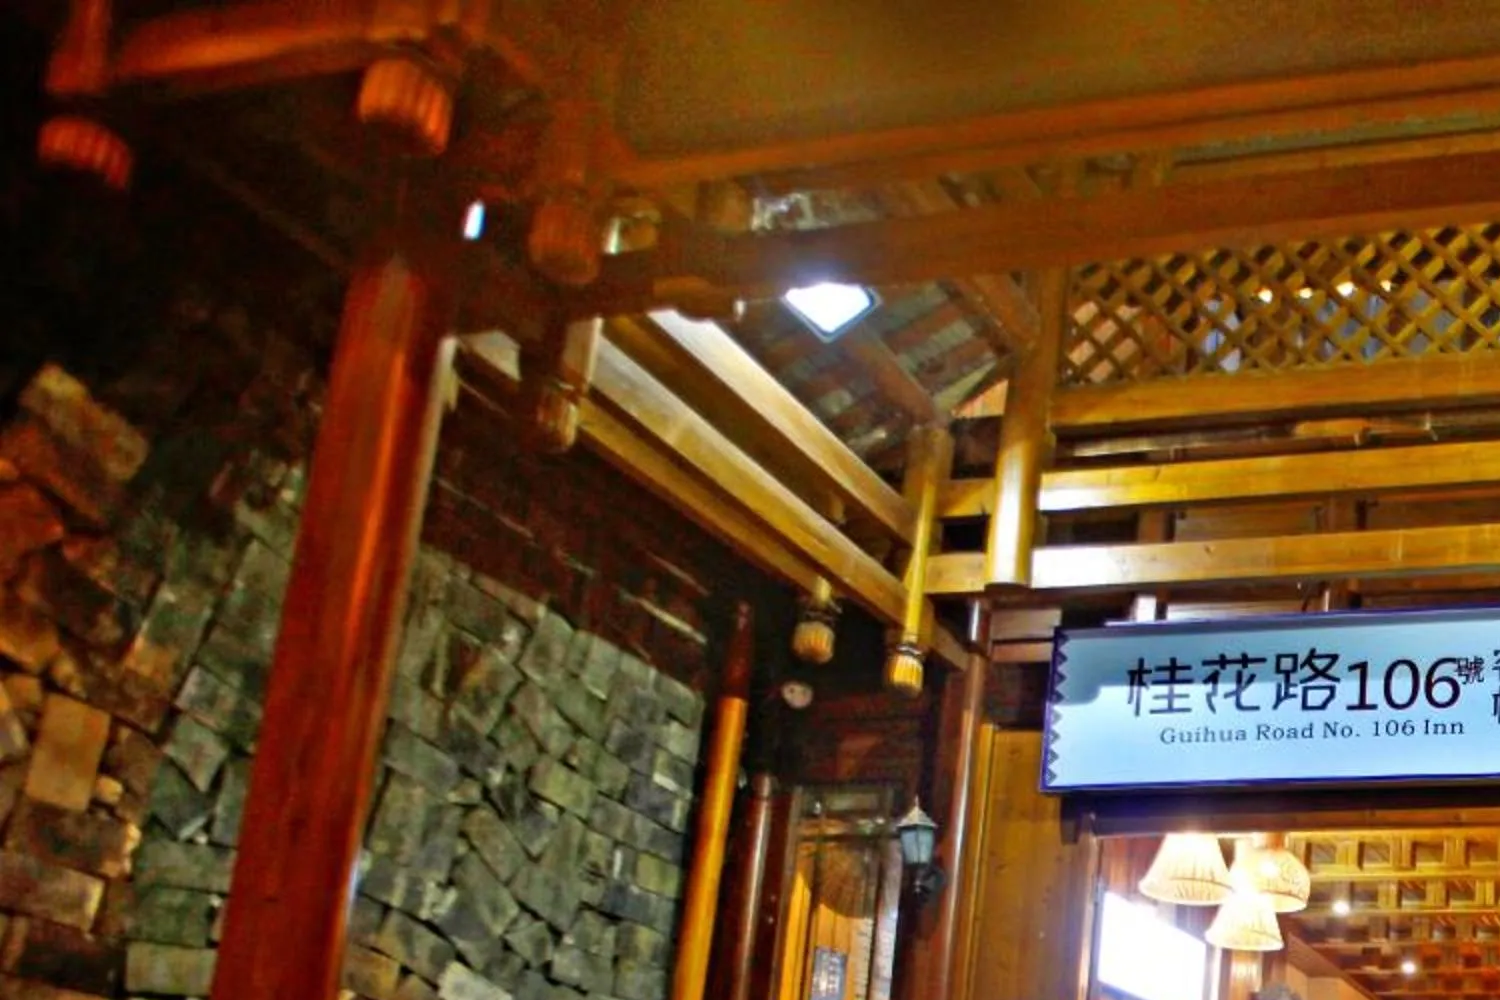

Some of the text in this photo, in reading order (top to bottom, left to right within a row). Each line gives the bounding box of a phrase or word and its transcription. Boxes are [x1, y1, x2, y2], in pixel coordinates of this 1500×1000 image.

[1159, 718, 1465, 745] Guihua Road No. 106 Inn
